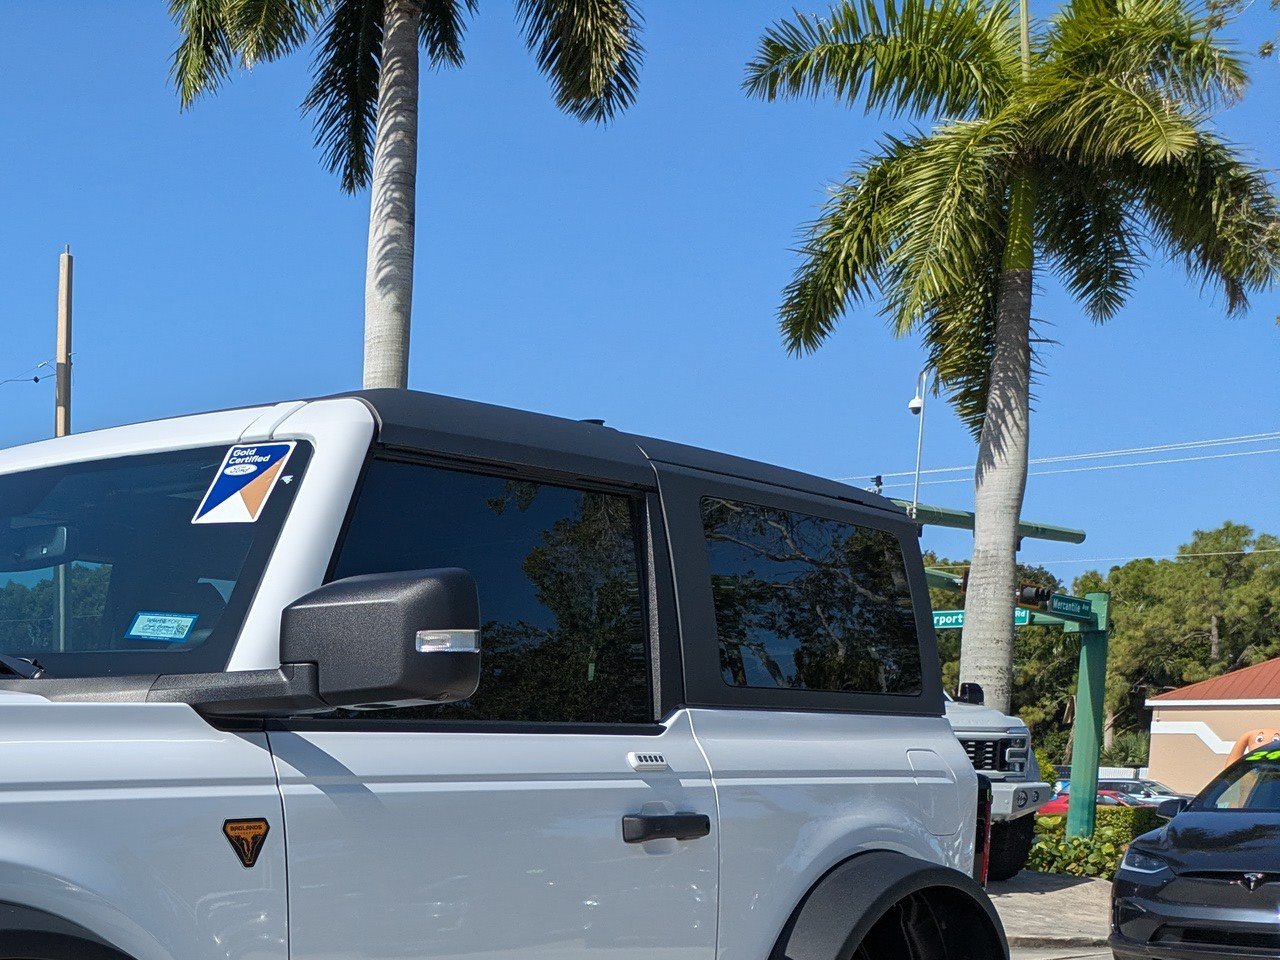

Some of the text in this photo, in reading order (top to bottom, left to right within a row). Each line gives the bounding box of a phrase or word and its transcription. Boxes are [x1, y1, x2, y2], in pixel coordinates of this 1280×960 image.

[233, 448, 257, 456] Gold
[228, 454, 272, 465] Certified
[1052, 597, 1082, 614] Mercantile
[933, 610, 1026, 625] rport Rd
